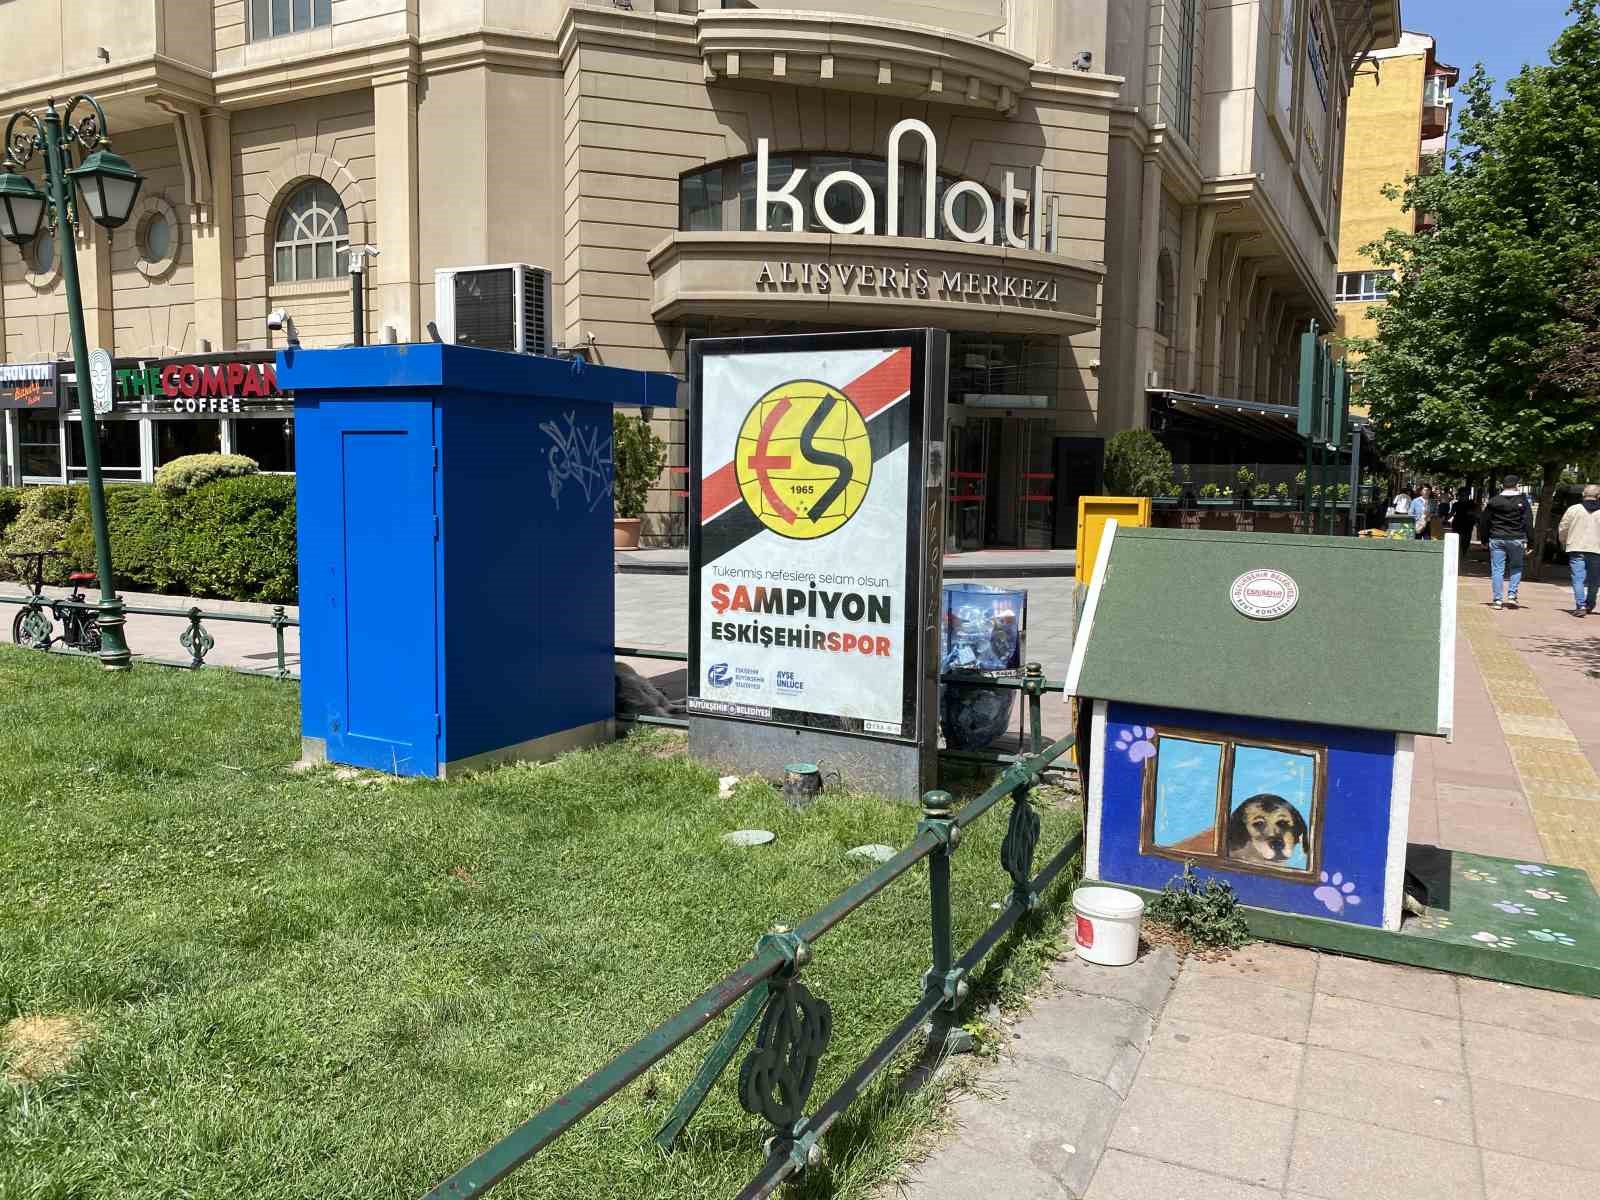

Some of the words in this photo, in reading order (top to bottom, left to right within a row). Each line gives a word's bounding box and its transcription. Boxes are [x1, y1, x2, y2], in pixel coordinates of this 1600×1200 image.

[757, 261, 928, 293] ALIŞVERİŞ
[941, 270, 1057, 301] MERKEZİ
[115, 367, 162, 395] THE
[173, 398, 241, 413] COFFEE
[790, 485, 814, 494] 1965
[819, 573, 855, 586] selam
[857, 575, 889, 588] olsun
[711, 581, 891, 624] ŞAMPİYON
[711, 619, 892, 657] ESKİŞEHİRSPOR
